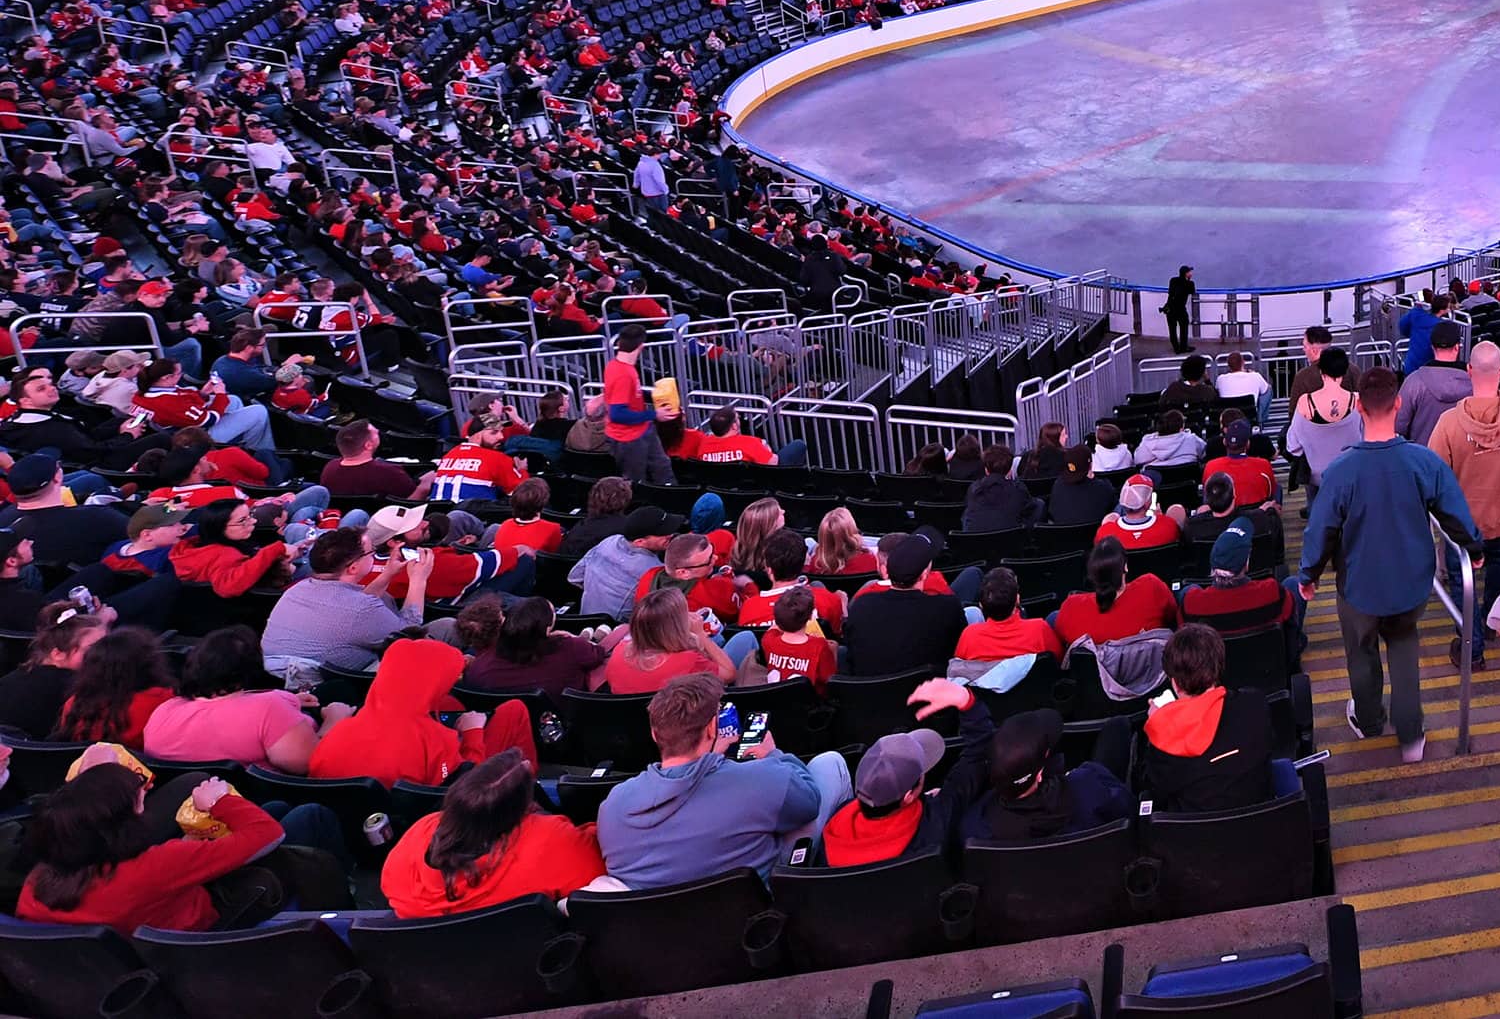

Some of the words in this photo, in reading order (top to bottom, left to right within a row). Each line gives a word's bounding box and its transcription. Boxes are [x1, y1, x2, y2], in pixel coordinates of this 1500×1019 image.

[702, 449, 743, 463] CAUFIELD
[435, 474, 465, 504] 11
[768, 652, 810, 672] HUTSON
